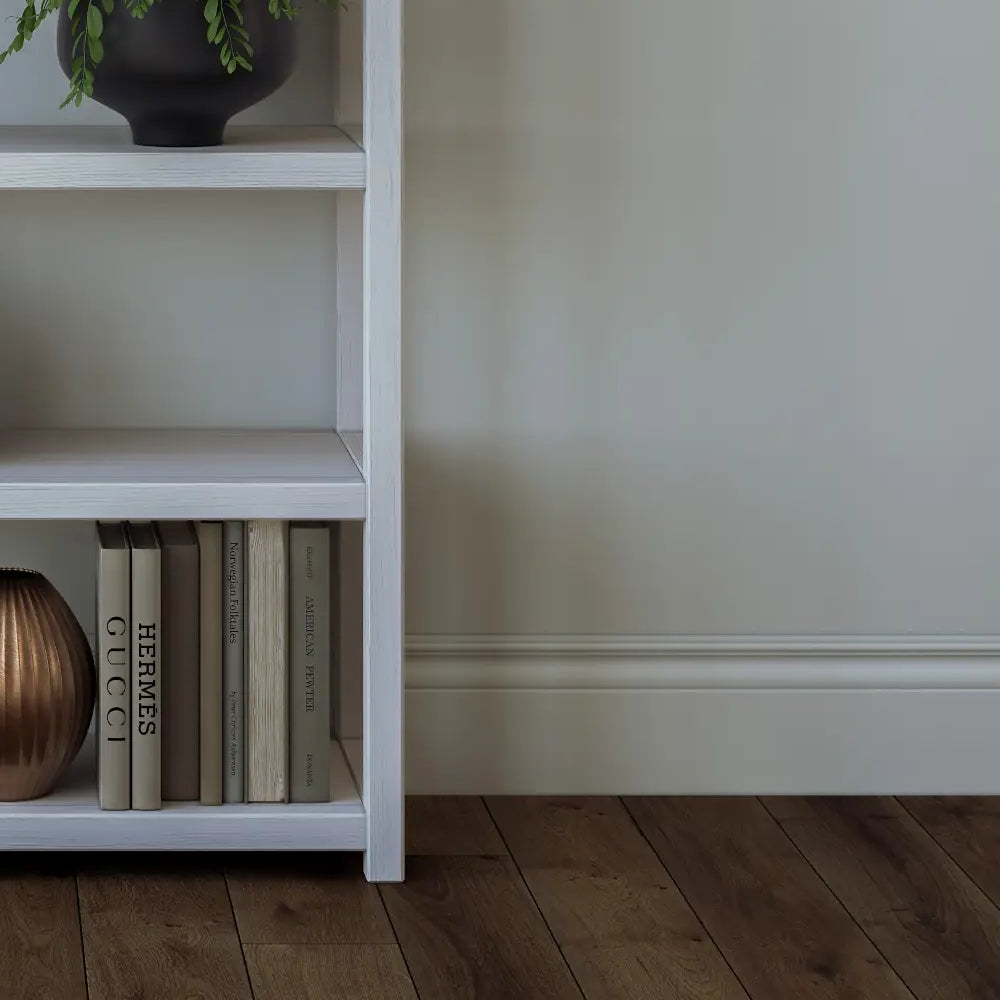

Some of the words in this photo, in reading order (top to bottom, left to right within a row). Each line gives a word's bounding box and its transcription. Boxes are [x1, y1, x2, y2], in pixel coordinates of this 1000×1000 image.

[227, 542, 239, 596] Norwegian
[229, 600, 239, 644] Folktales
[305, 596, 315, 656] AMERICAN
[106, 616, 127, 742] GUCCI
[305, 665, 315, 713] PEWTER
